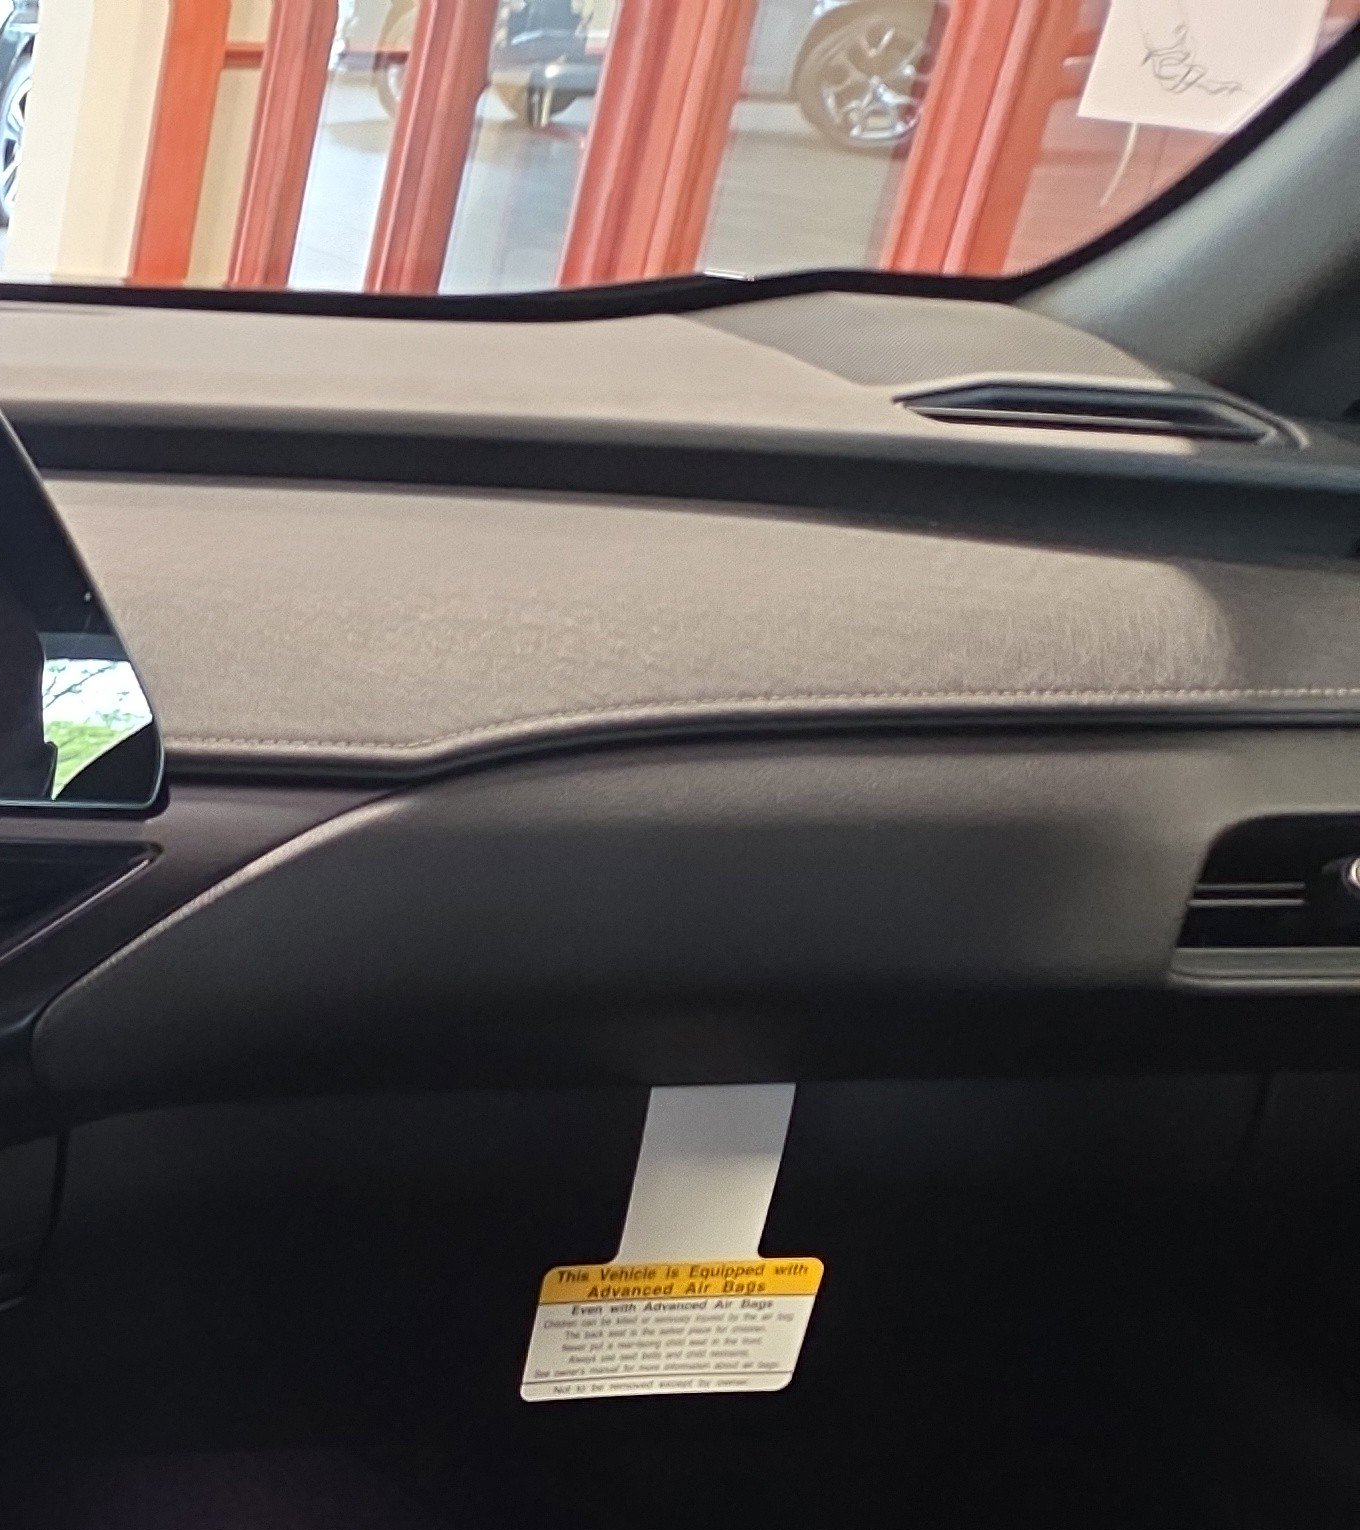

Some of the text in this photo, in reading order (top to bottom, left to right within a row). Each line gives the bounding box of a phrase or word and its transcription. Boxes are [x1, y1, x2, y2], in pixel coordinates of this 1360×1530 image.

[558, 1263, 809, 1284] This Vehicle is Equipped with
[587, 1279, 766, 1298] Advanced Air Bags
[571, 1298, 773, 1316] Even with Advanced Air Bags
